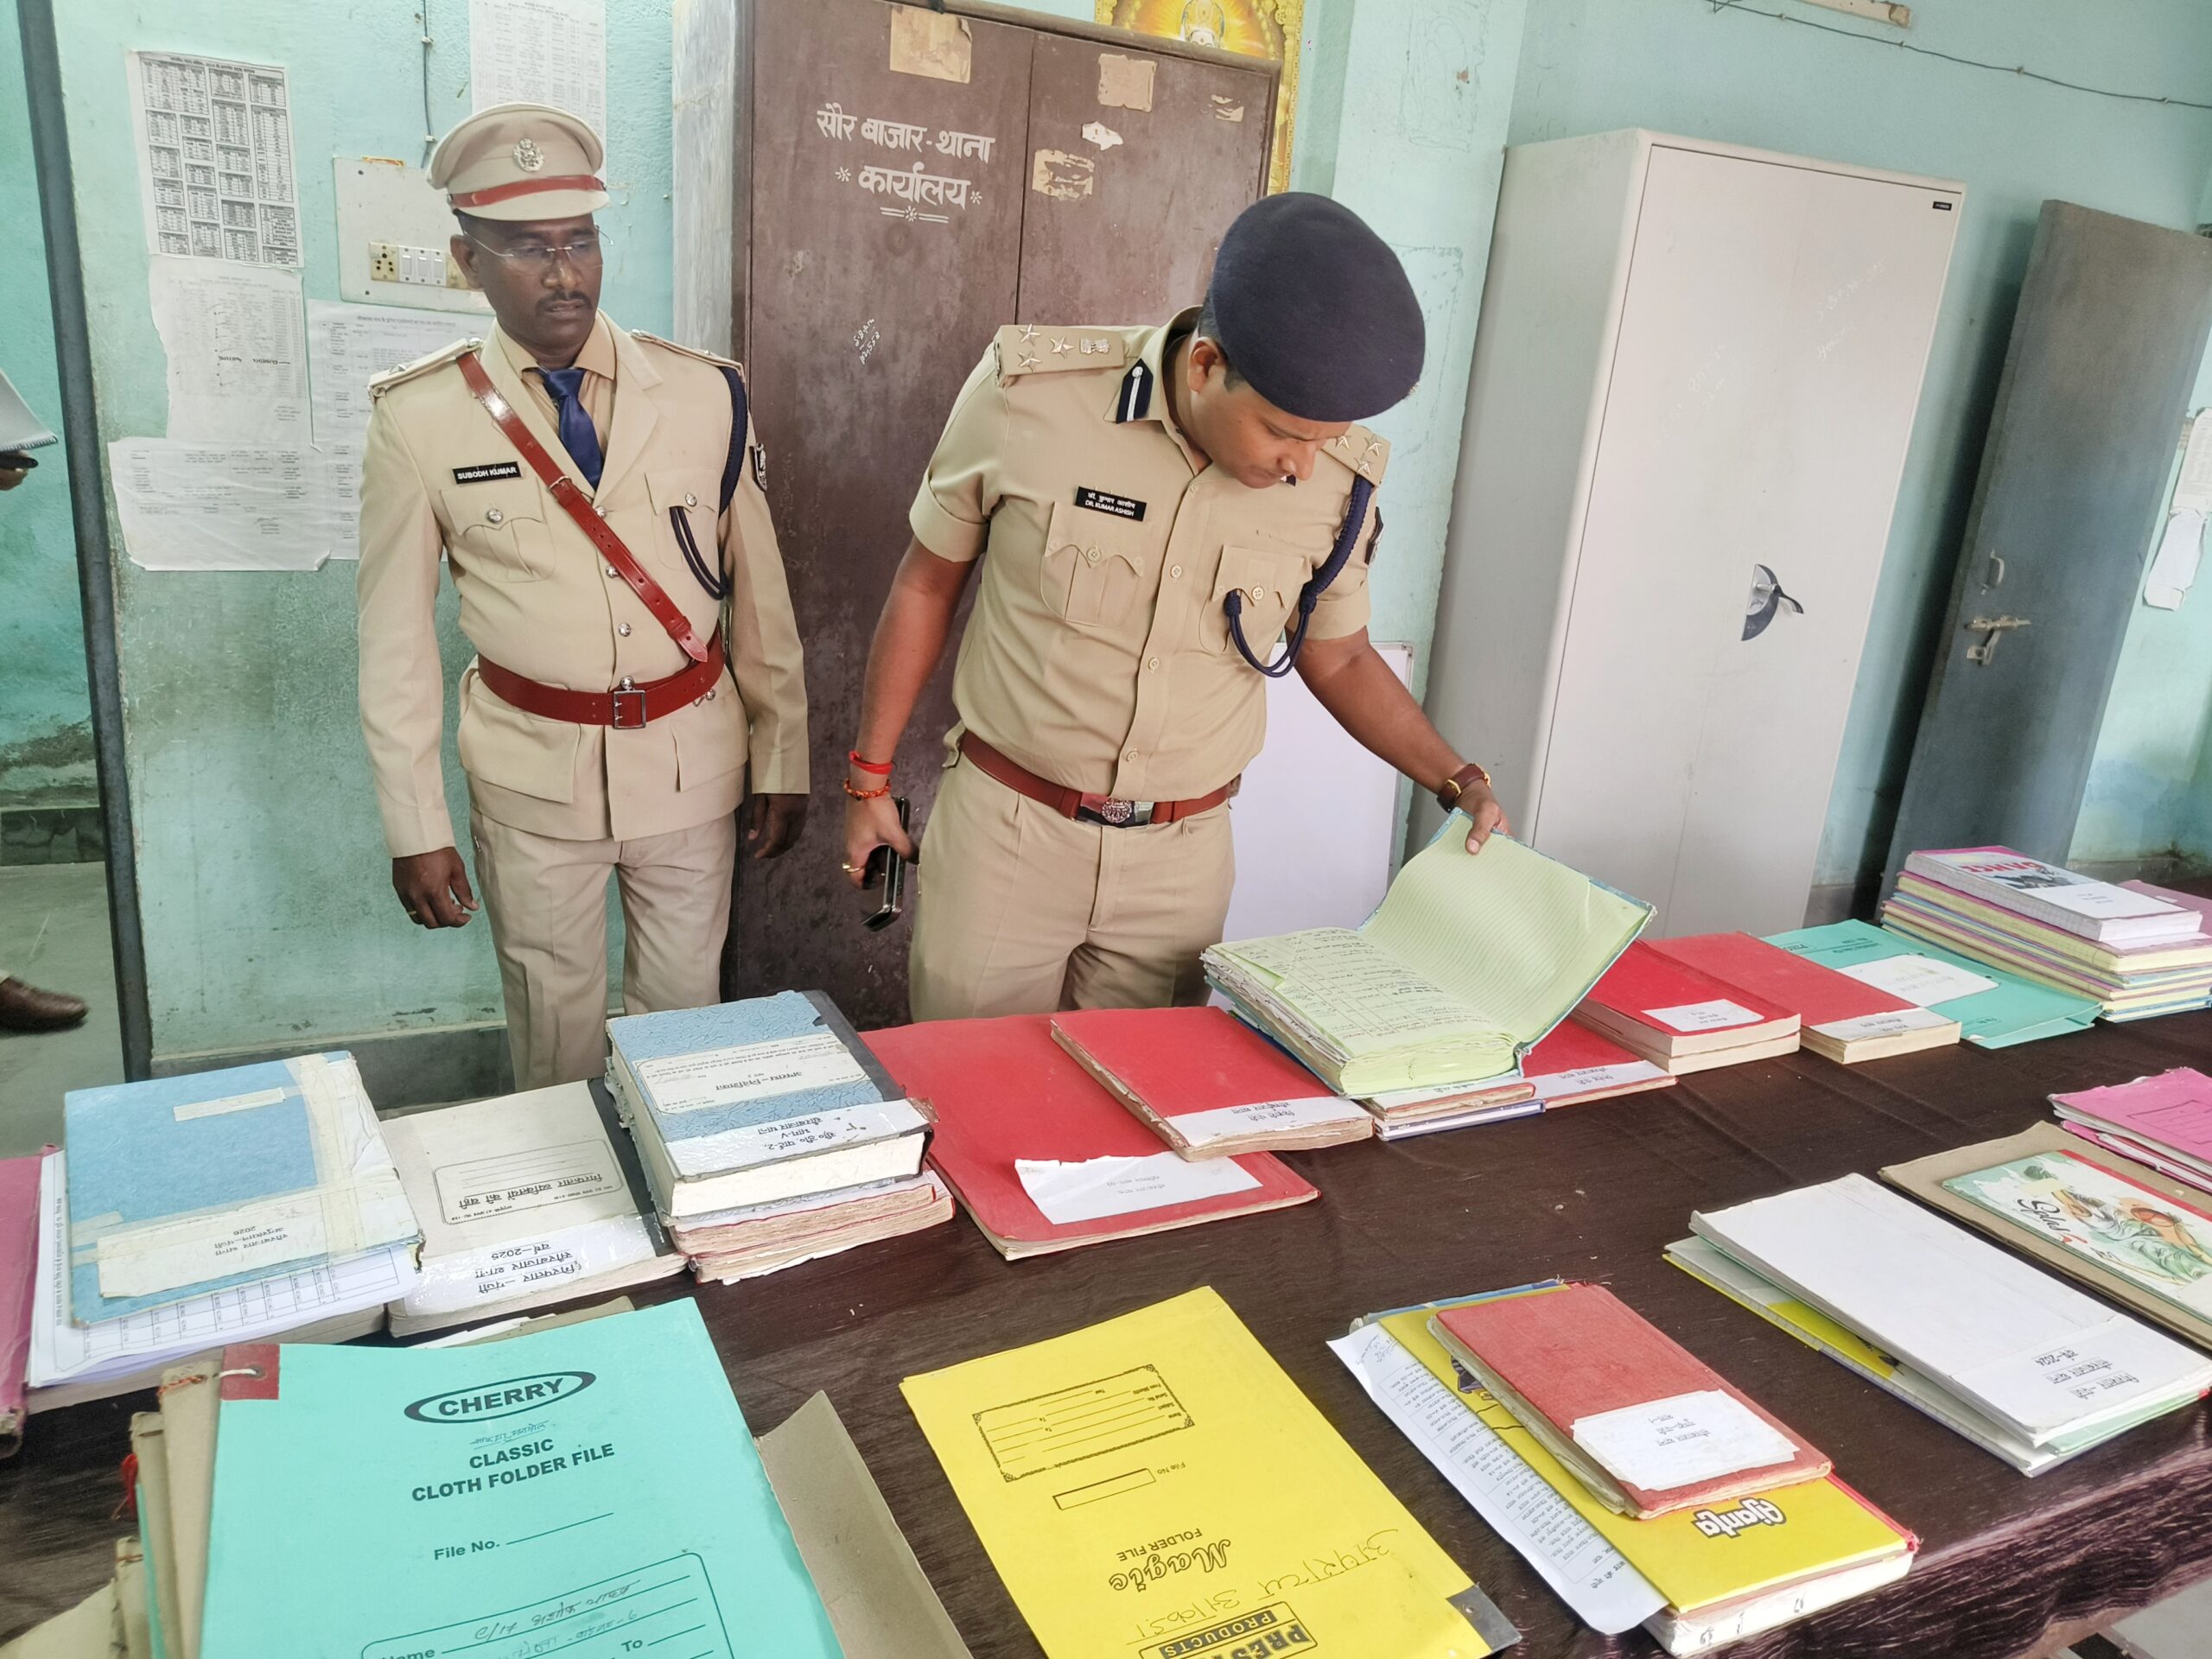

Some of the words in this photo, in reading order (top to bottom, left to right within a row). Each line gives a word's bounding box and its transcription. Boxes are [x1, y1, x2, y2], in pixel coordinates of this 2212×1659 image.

[817, 102, 858, 142] सौर
[858, 162, 971, 210] कार्यालय
[457, 470, 489, 480] SUBODH
[489, 467, 518, 476] KUMAR
[1097, 495, 1116, 504] कुमार
[1095, 502, 1115, 512] KUMAR
[1115, 507, 1135, 517] ASHISH
[757, 1123, 779, 1135] थाना
[484, 1192, 501, 1205] की
[214, 1246, 238, 1256] थाना
[512, 1250, 574, 1273] सौरबाजार
[474, 1266, 505, 1279] थाना
[523, 1262, 575, 1283] गिरफ्तार
[2046, 1373, 2071, 1384] थाना
[438, 1377, 564, 1417] CHERRY
[469, 1438, 555, 1469] CLASSIC
[411, 1477, 482, 1503] CLOTH
[488, 1457, 568, 1488] FOLDER
[572, 1444, 615, 1466] FILE
[1157, 1466, 1170, 1475] No
[1171, 1461, 1186, 1472] File
[1148, 1528, 1203, 1552] FOLDER
[434, 1546, 467, 1561] File
[471, 1541, 500, 1554] No.
[1116, 1544, 1147, 1562] FILE
[1109, 1539, 1231, 1592] Magic
[1164, 1612, 1274, 1656] PRODUCTS
[621, 1638, 644, 1654] To
